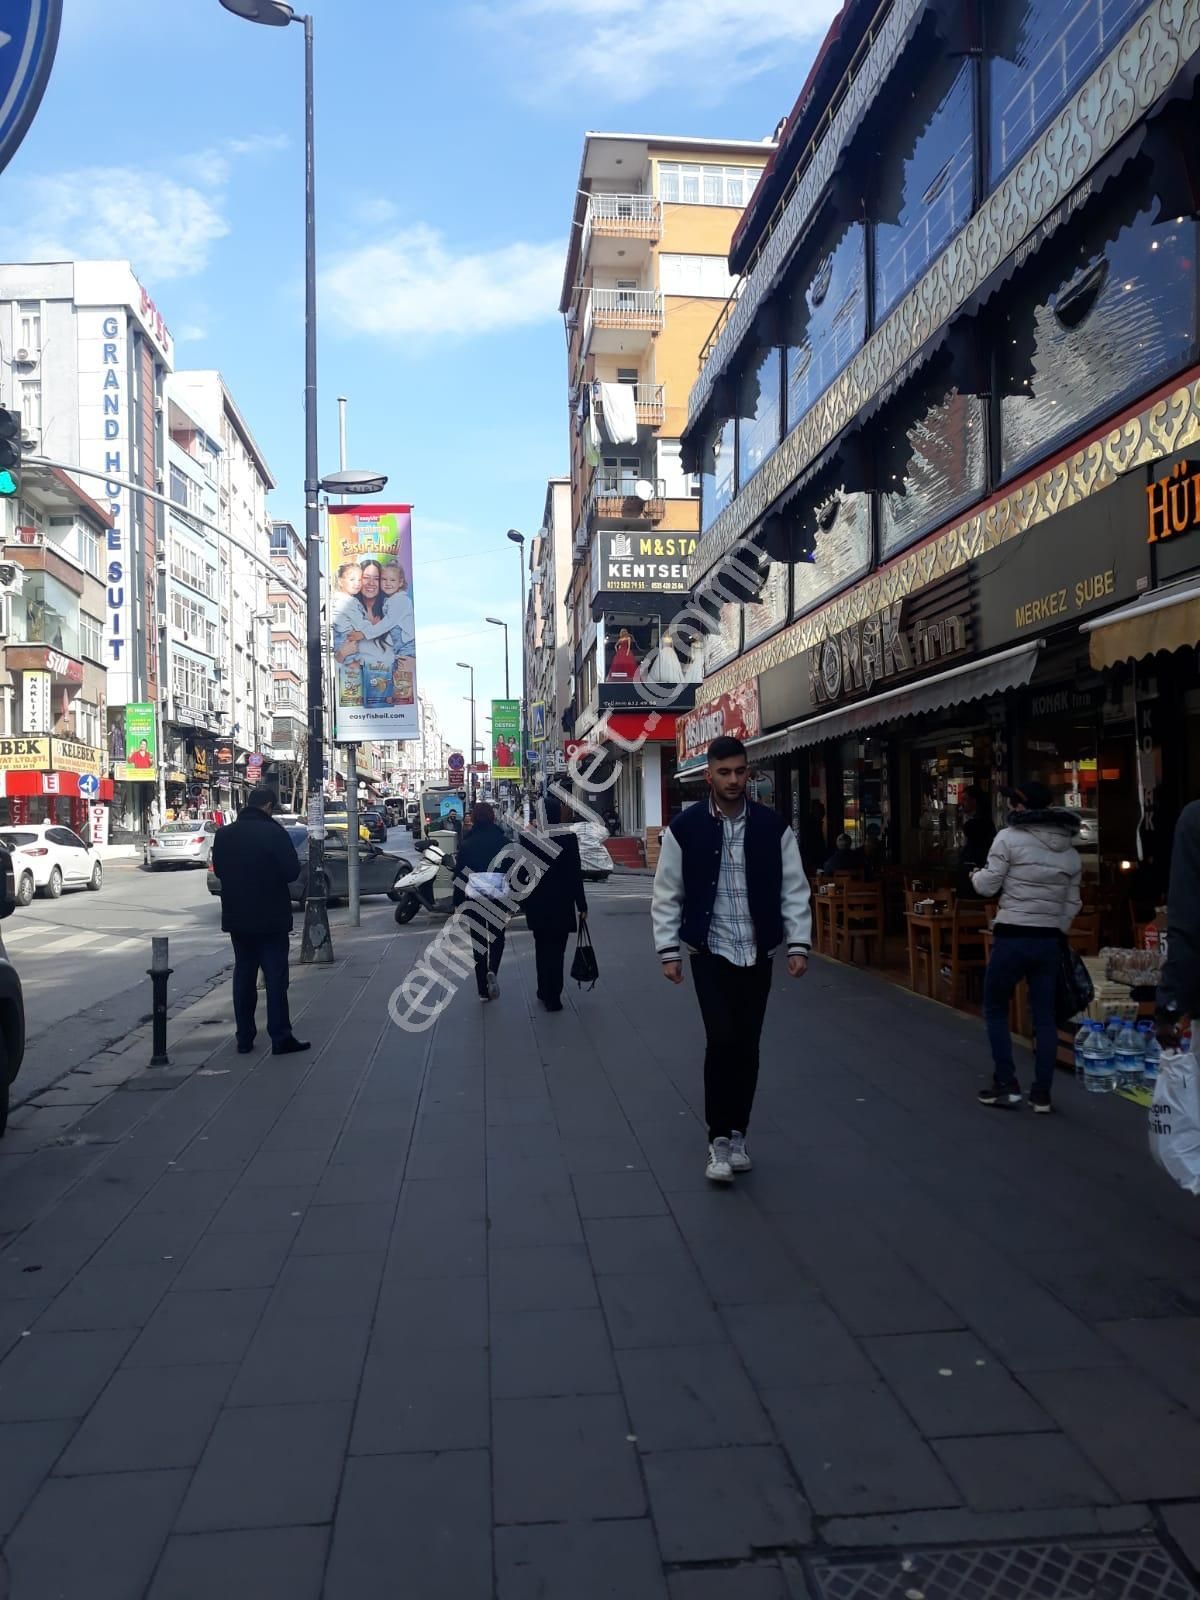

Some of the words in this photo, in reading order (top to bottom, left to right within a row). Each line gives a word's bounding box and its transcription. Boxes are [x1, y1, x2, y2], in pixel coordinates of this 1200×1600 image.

[103, 317, 119, 440] GRAND
[107, 561, 124, 660] SUIT
[1015, 588, 1068, 628] MERKEZ
[1075, 570, 1115, 610] ŞUBE
[808, 599, 912, 705] KONAK
[61, 743, 96, 762] KELEBEK
[348, 712, 405, 721] easyfishoil.com
[1143, 708, 1156, 831] KOAK
[93, 808, 104, 843] OTEL
